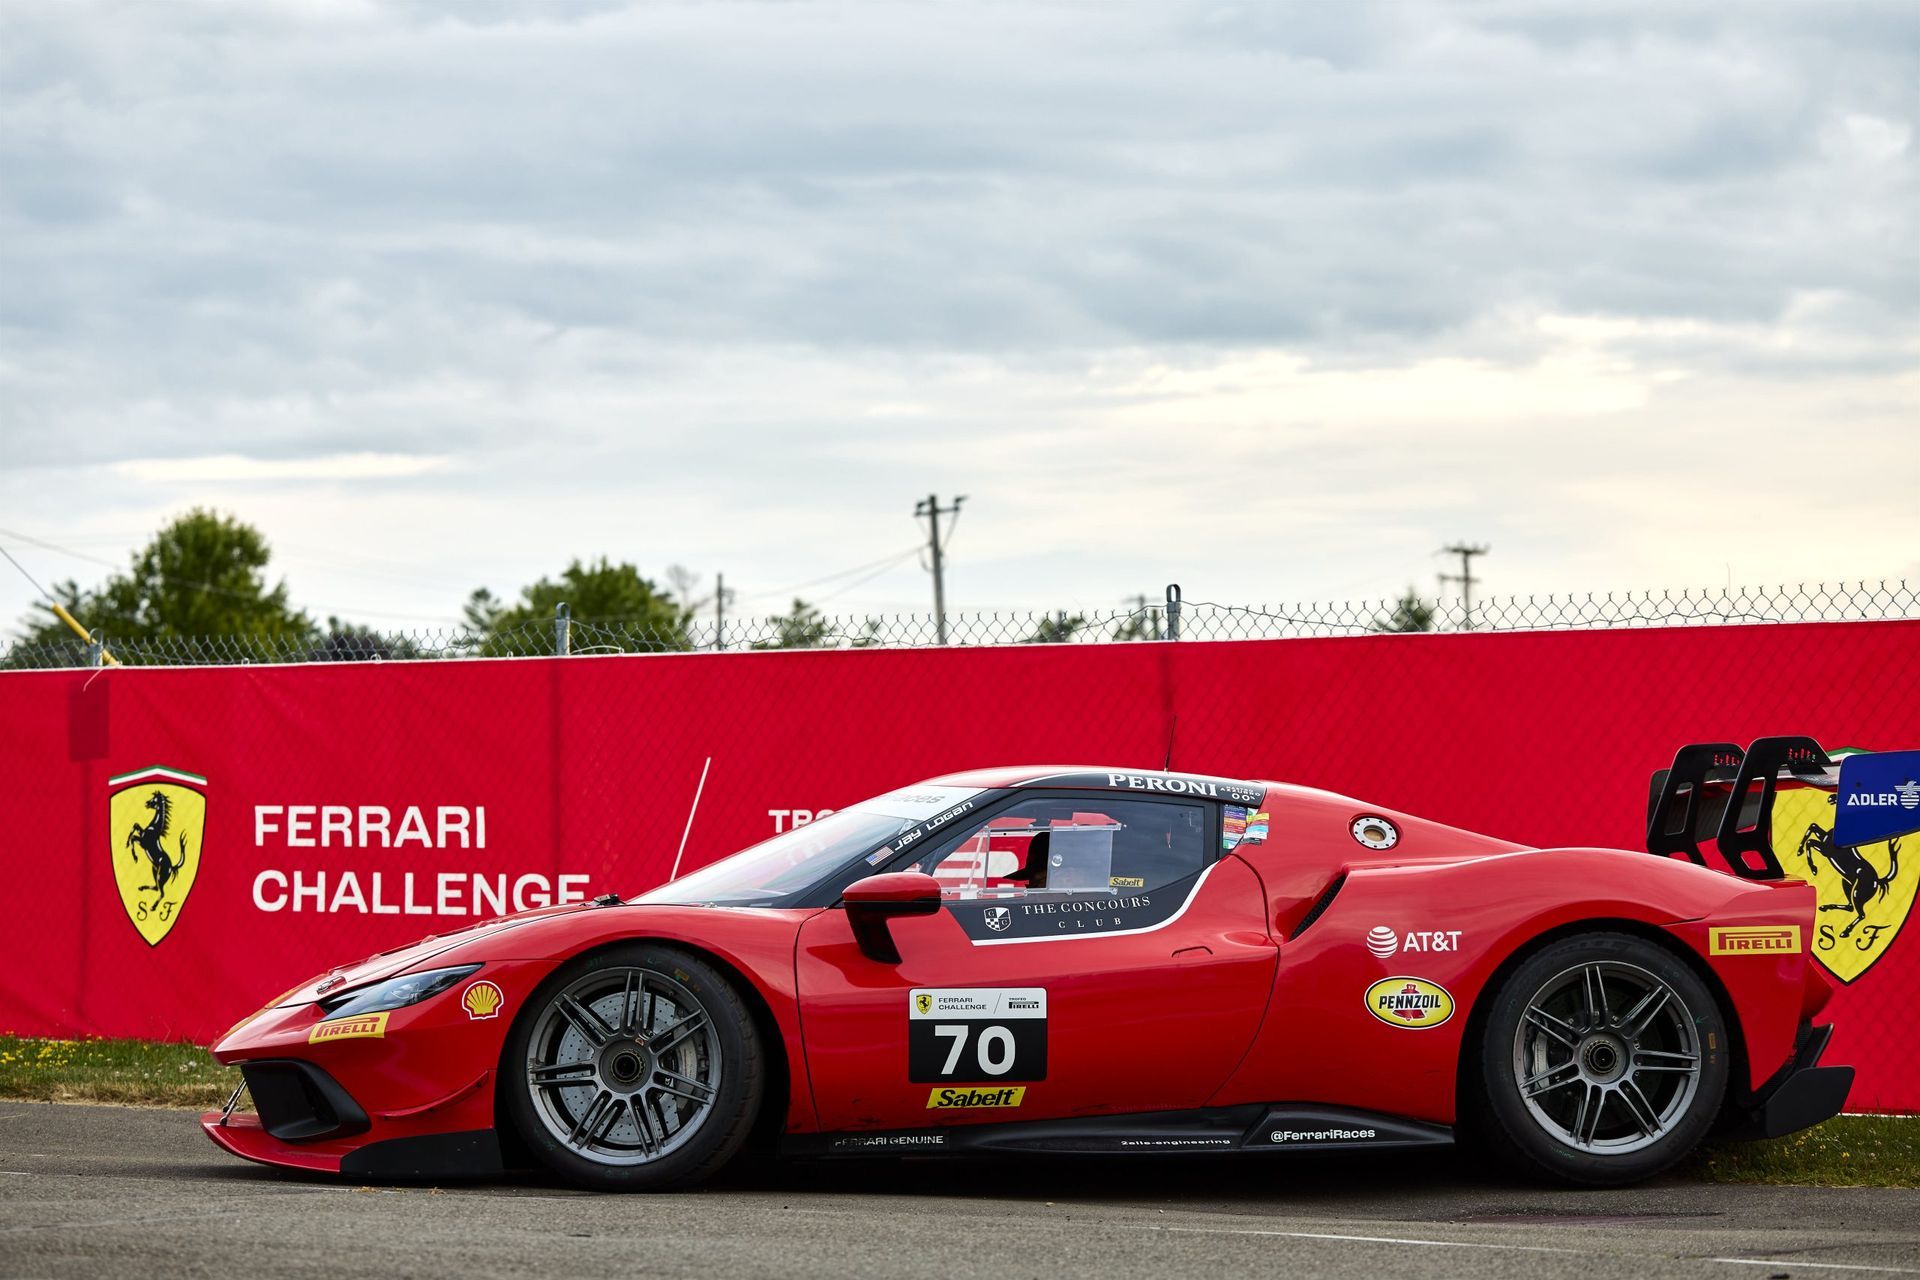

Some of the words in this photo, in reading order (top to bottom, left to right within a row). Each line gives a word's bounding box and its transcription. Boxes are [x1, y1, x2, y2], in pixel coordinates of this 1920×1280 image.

[1107, 773, 1218, 797] PERONI
[1847, 793, 1898, 806] ADLER
[253, 804, 486, 849] FERRARI
[1112, 877, 1141, 887] Sabelt
[251, 869, 591, 917] CHALLENGE
[1021, 903, 1057, 915] THE
[1060, 896, 1151, 913] CONCOURS
[1058, 917, 1122, 929] CLUB
[1402, 930, 1462, 952] AT&T
[1717, 931, 1793, 951] PIRELLI
[1008, 1001, 1039, 1009] PIRELLI
[1378, 994, 1441, 1009] PENNZOIL
[315, 1016, 381, 1038] PIRELLI
[934, 1024, 1016, 1076] 70
[937, 1089, 1015, 1107] Sabelt
[889, 1135, 944, 1146] GENUINE
[1270, 1129, 1376, 1143] @FerrariRaces
